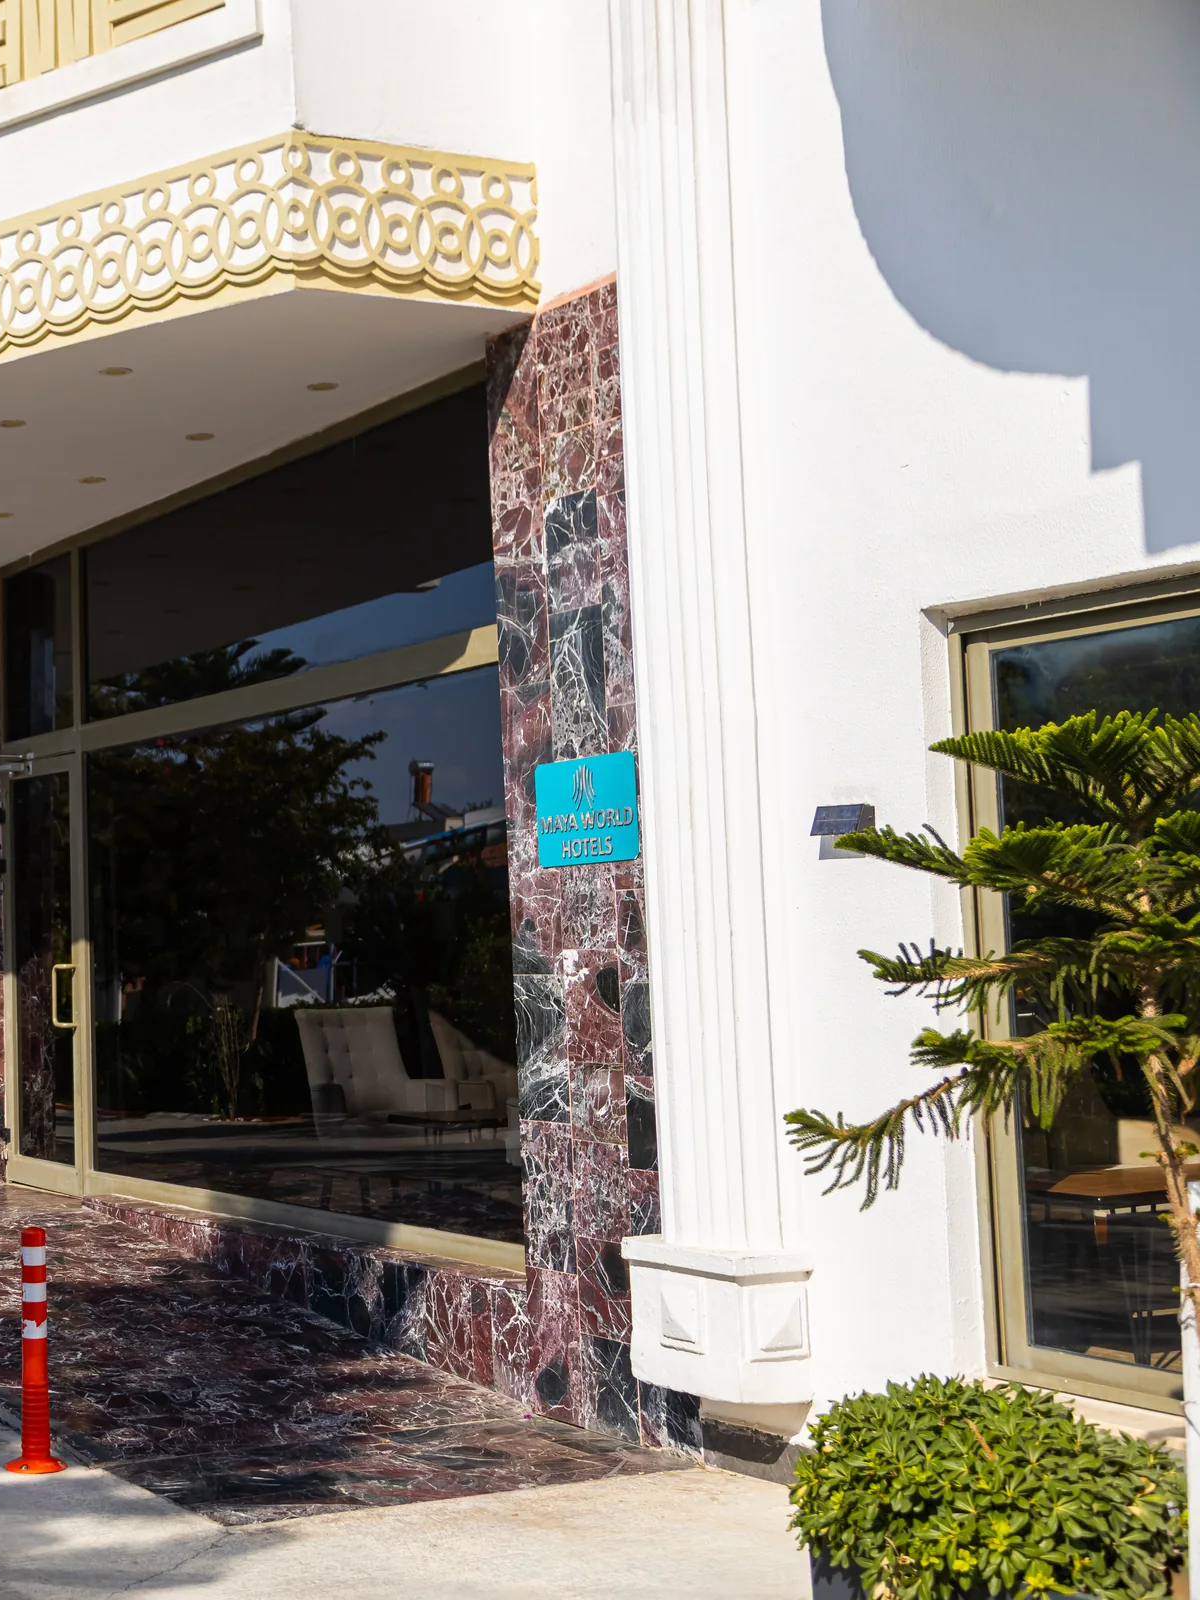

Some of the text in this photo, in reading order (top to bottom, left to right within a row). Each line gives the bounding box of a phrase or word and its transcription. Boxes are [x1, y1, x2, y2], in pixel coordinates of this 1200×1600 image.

[540, 806, 634, 834] MAYA WORLD
[561, 835, 614, 859] HOTELS
